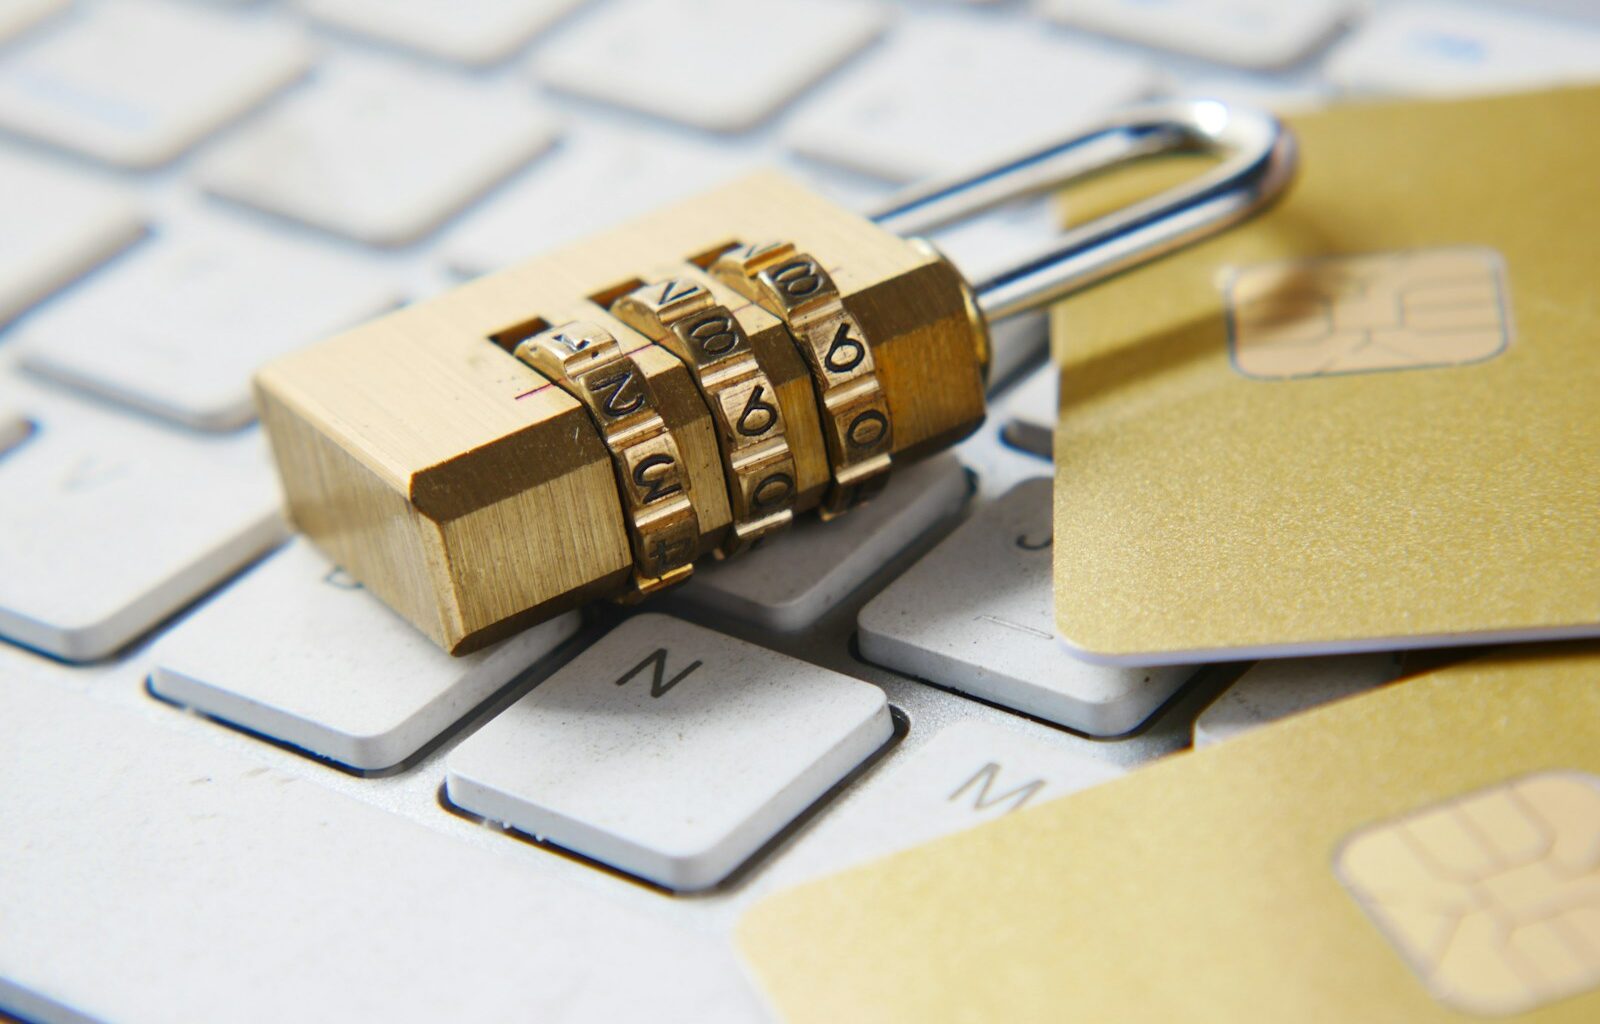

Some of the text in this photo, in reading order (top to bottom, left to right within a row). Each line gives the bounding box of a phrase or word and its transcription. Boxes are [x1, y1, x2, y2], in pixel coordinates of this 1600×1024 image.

[771, 261, 823, 297] 8
[687, 316, 739, 356] 8
[590, 370, 646, 418] 2
[633, 453, 684, 505] 3
[615, 647, 703, 698] N
[946, 761, 1047, 814] M
